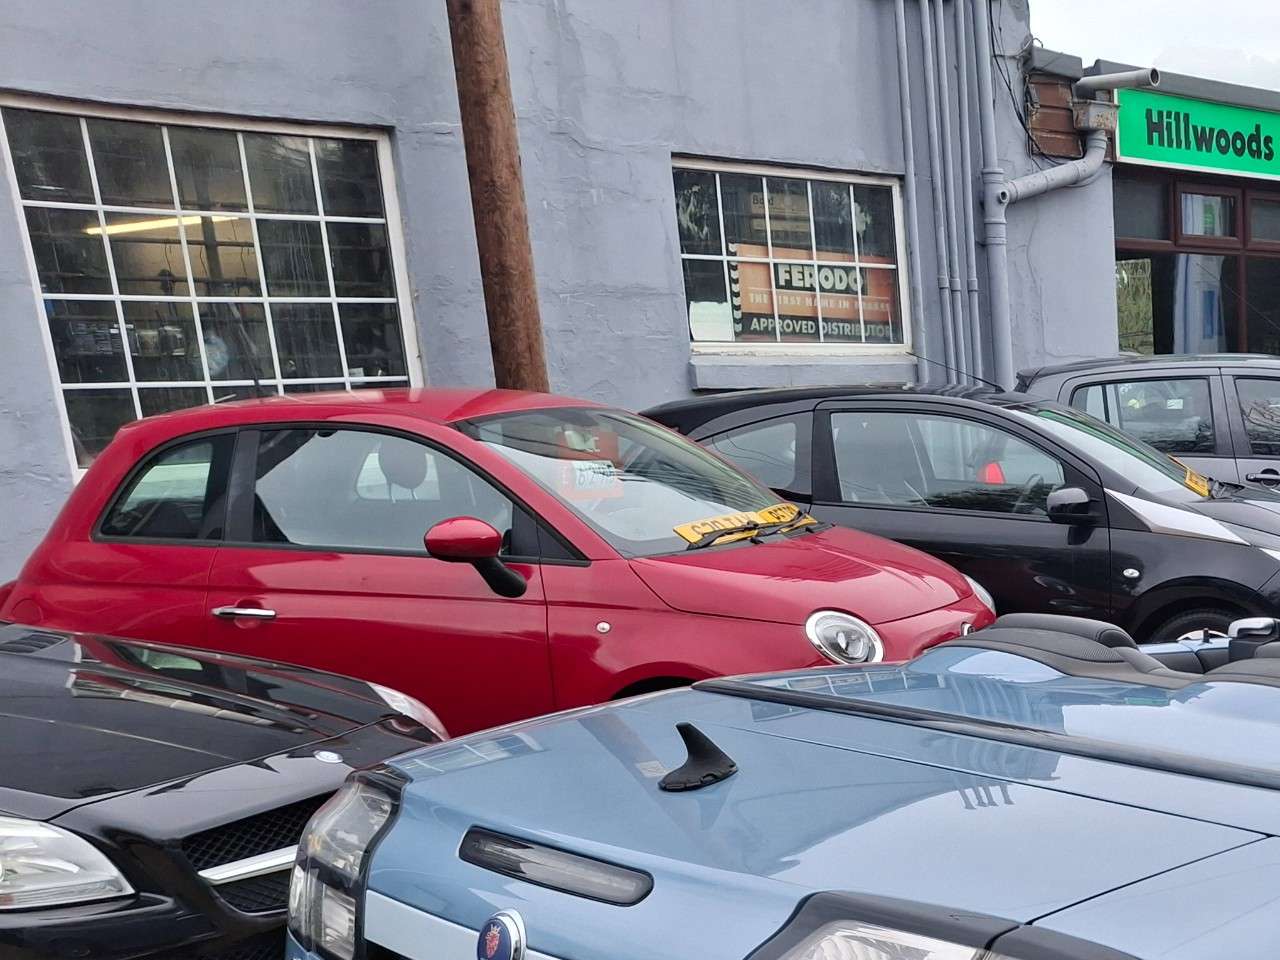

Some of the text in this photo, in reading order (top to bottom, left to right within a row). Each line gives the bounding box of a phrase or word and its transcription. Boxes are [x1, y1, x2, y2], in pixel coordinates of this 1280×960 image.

[1145, 108, 1275, 161] Hillwoods
[777, 263, 864, 292] FERODO
[750, 317, 890, 337] APPROVED DISTRIBUTOR
